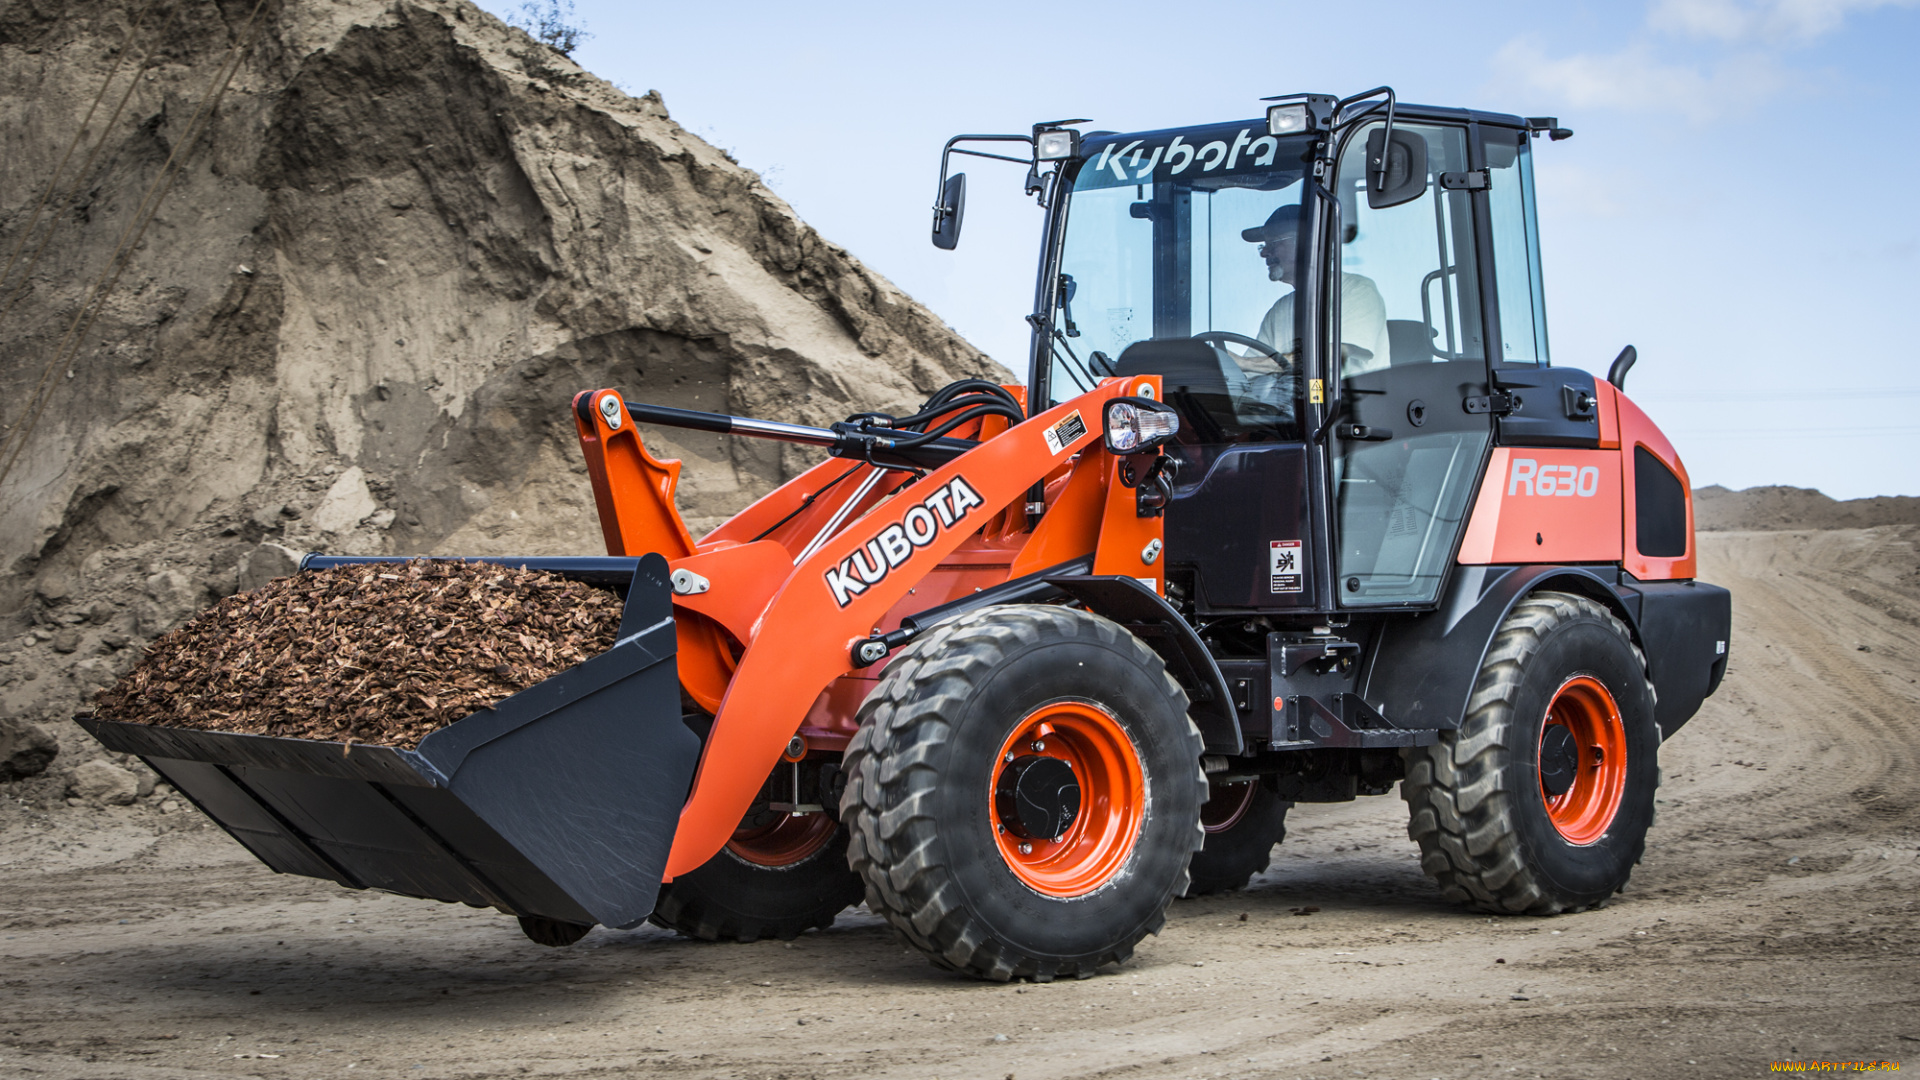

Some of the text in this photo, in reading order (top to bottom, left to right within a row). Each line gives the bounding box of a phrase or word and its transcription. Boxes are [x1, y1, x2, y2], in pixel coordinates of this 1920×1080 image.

[1095, 128, 1278, 181] Kubota
[1507, 458, 1600, 497] R630
[824, 474, 984, 608] KUBOTA
